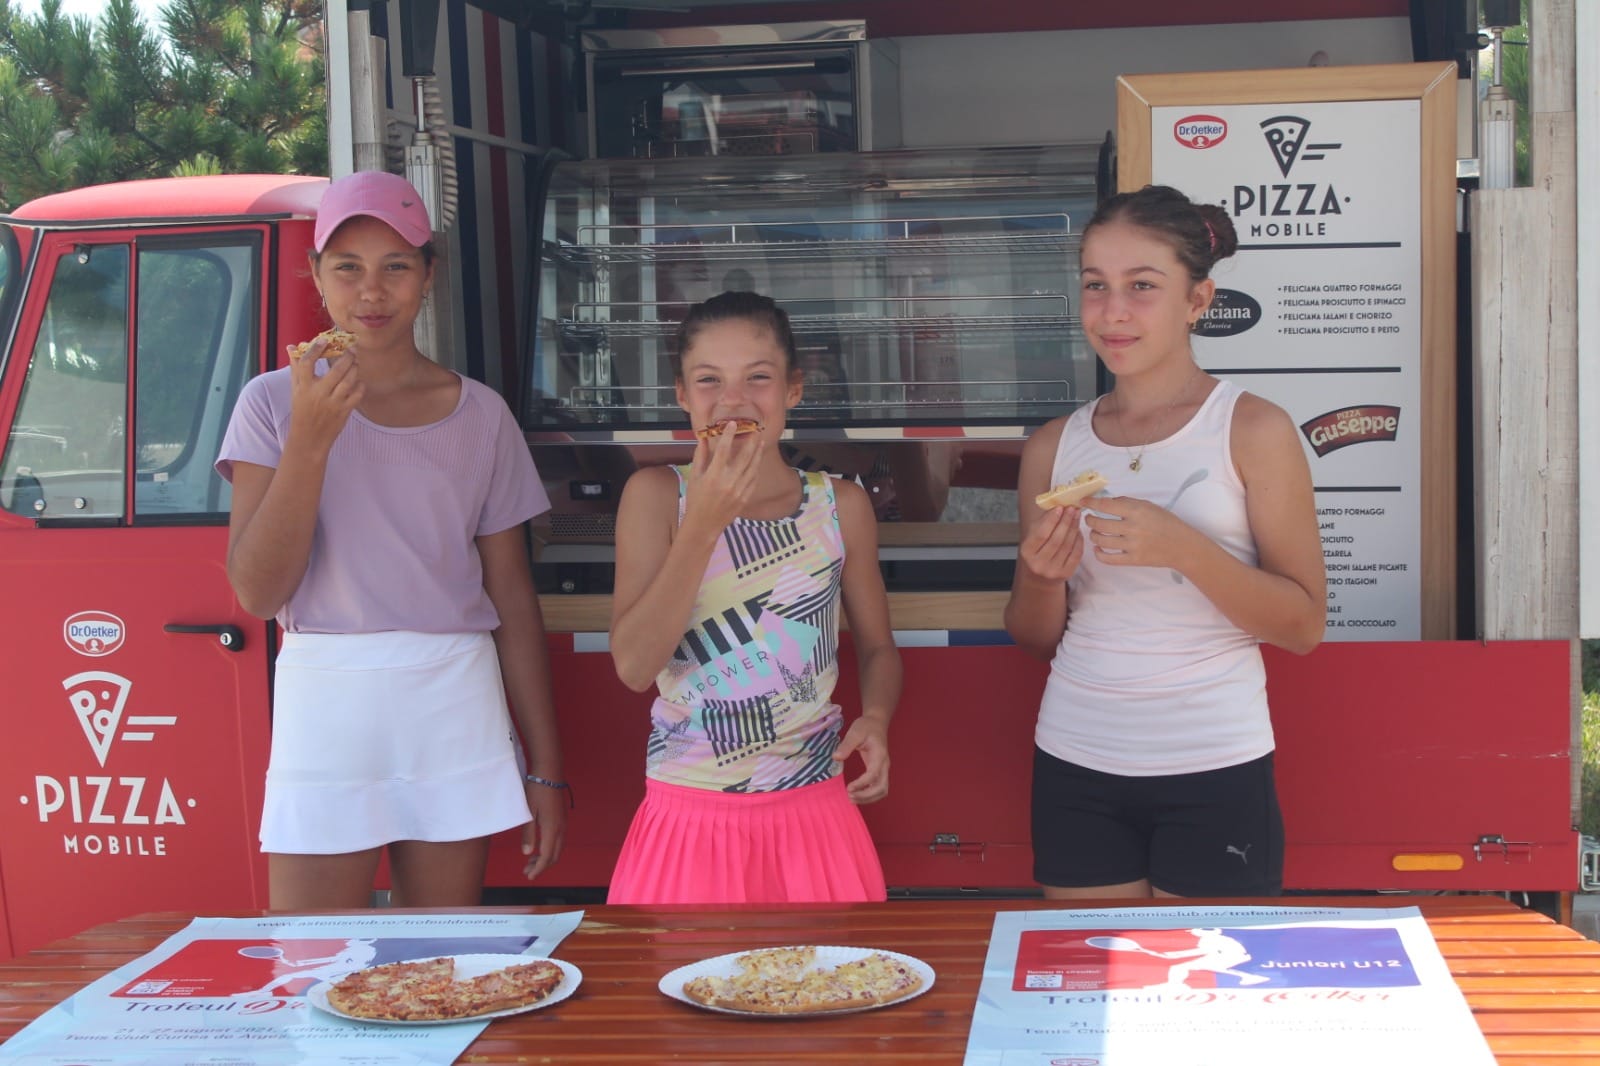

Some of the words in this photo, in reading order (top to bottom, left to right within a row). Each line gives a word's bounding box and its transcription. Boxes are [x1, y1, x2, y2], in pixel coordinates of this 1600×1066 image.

[1234, 184, 1342, 217] PIZZA
[1251, 222, 1326, 237] MOBILE
[1283, 285, 1321, 293] FELICIANA
[1323, 284, 1358, 292] QUATTRO
[1360, 283, 1402, 292] FORMAGGI
[1283, 299, 1320, 307] FELICIANA
[1321, 298, 1366, 306] PROSCIUTTO
[1367, 298, 1372, 306] E
[1349, 312, 1354, 320] E
[1336, 408, 1361, 421] PIZZA
[1310, 415, 1397, 447] Guseppe
[1316, 508, 1343, 516] UATTRO
[1345, 508, 1385, 516] FORMAGGI
[1379, 563, 1409, 571] PICANTE
[1347, 620, 1397, 628] CIOCCOLATO
[35, 775, 186, 825] PIZZA
[63, 834, 167, 856] MOBILE
[1260, 959, 1347, 969] Juniori
[1353, 959, 1403, 969] U12
[125, 1001, 238, 1012] Trofeul
